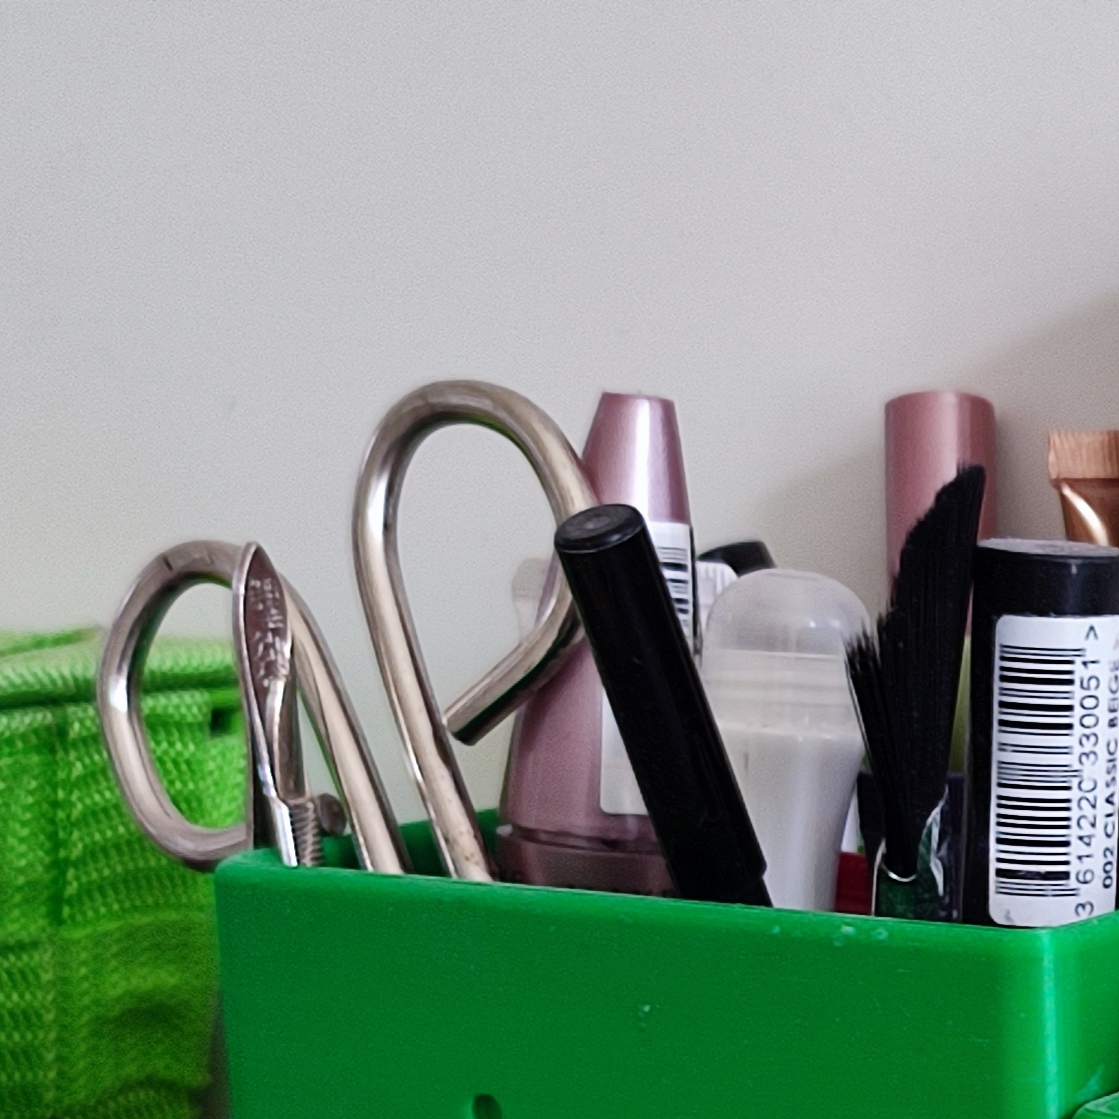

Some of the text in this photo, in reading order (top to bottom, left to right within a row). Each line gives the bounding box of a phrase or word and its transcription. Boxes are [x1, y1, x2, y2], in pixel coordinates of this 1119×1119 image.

[1079, 659, 1101, 767] 330051
[1104, 738, 1119, 839] CLASSIC
[1101, 846, 1115, 890] 002
[1074, 899, 1095, 918] 3
